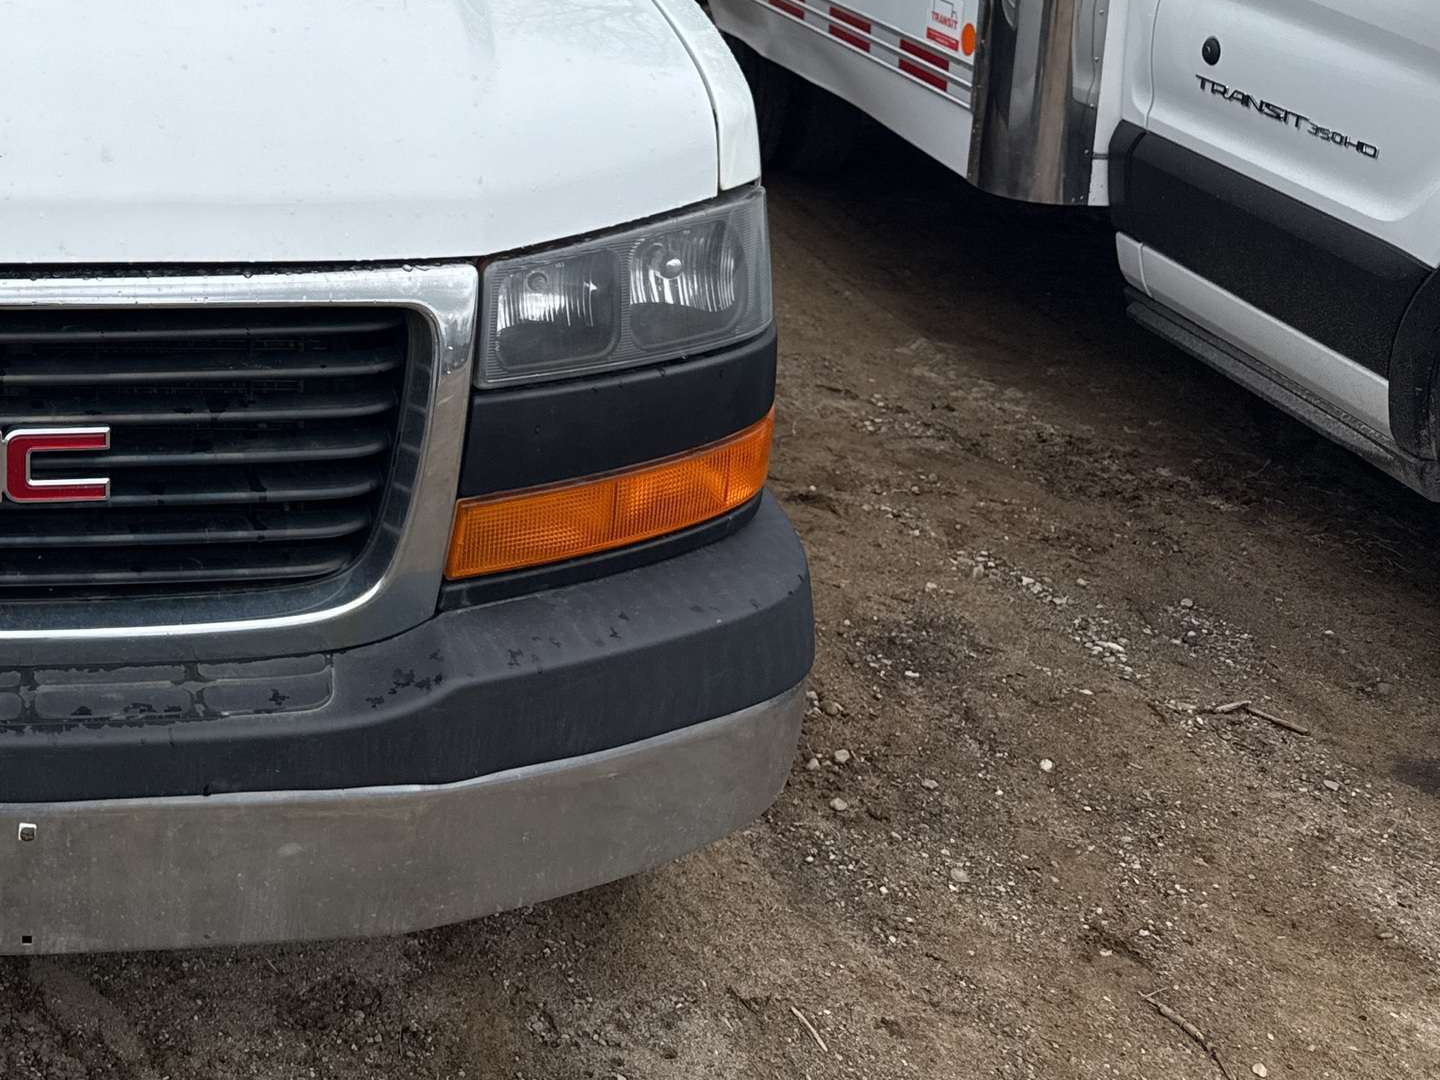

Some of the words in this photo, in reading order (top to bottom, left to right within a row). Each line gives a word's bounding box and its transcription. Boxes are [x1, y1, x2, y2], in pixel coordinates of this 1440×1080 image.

[931, 11, 958, 30] TRANSIT
[1195, 74, 1312, 131] TRANSIT
[1307, 123, 1380, 160] 350HD
